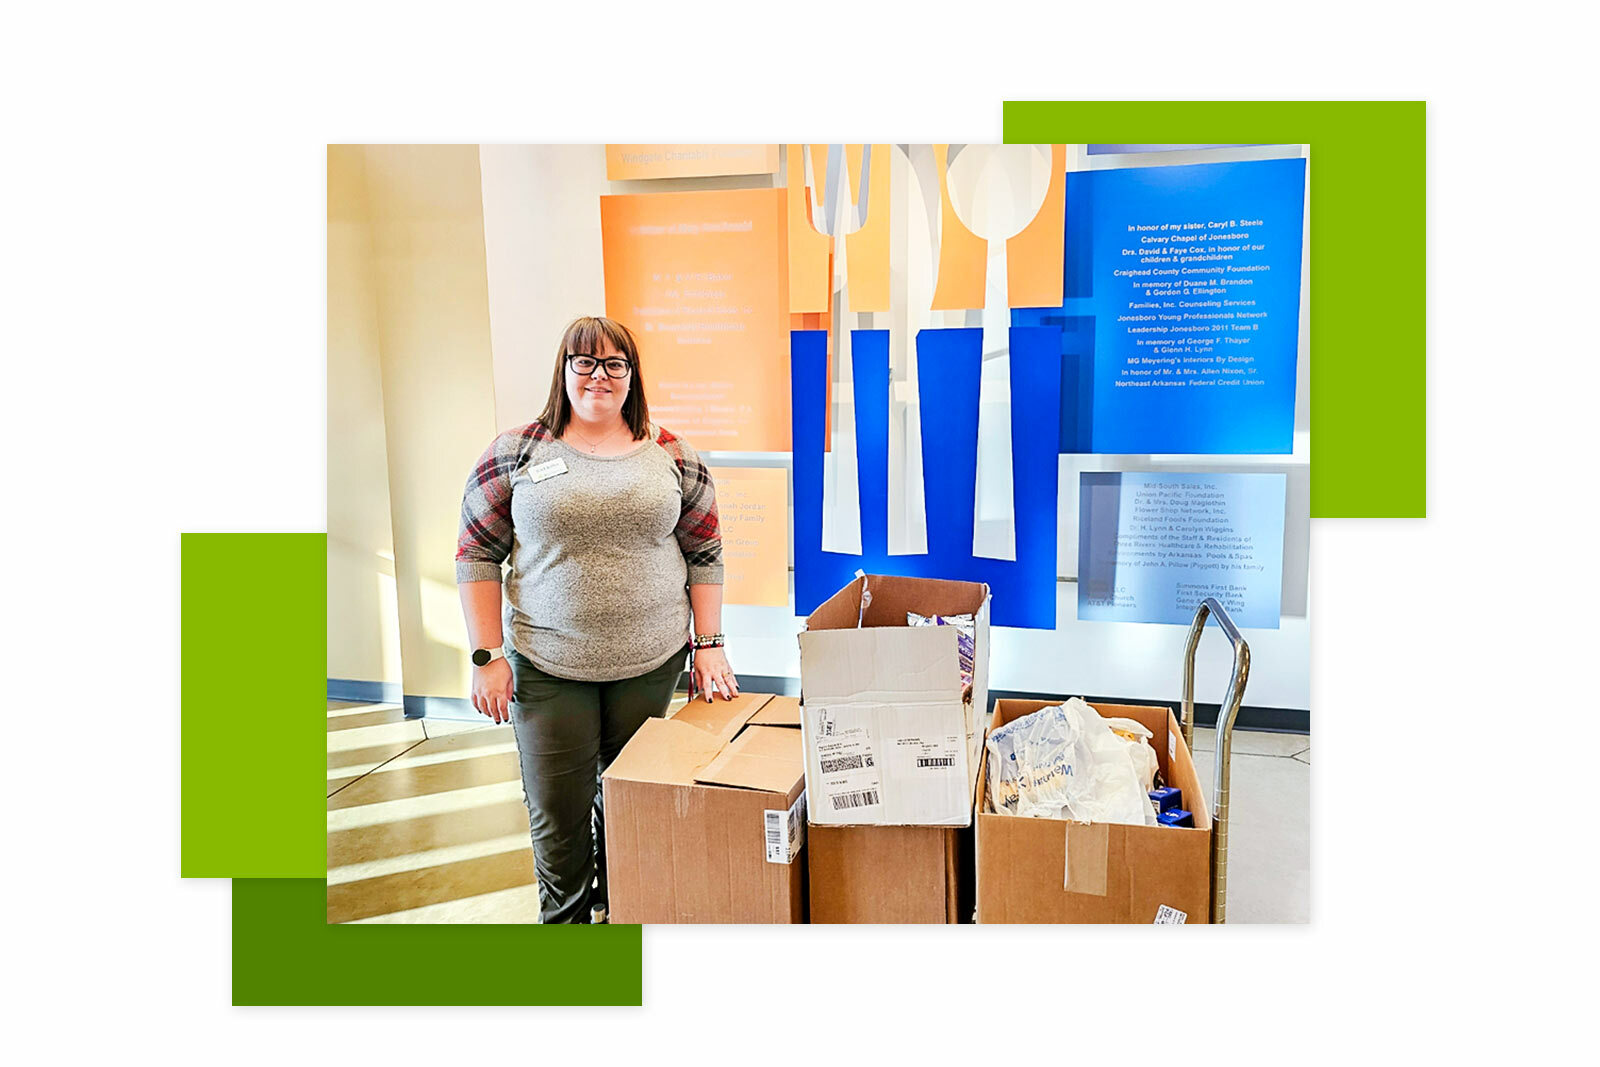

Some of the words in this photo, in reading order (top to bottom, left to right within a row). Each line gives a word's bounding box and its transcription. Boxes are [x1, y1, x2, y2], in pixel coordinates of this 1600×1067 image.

[1184, 222, 1205, 231] sister,
[1208, 221, 1228, 230] Caryl
[1240, 219, 1263, 227] Steele
[1141, 235, 1169, 245] Calvary
[1171, 234, 1197, 244] Chapel
[1209, 232, 1249, 240] Jonesboro
[1139, 247, 1160, 255] David
[1169, 246, 1187, 255] Faye
[1189, 246, 1205, 255] Cox,
[1217, 244, 1240, 252] honor
[1180, 254, 1233, 264] grandchildren
[1114, 268, 1151, 278] Craighead
[1153, 268, 1179, 277] County
[1181, 266, 1224, 276] Community
[1227, 265, 1270, 273] Foundation
[1183, 279, 1207, 287] Duane
[1153, 288, 1181, 296] Gordon
[1193, 287, 1226, 296] Ellington
[1129, 301, 1161, 310] Families,
[1179, 300, 1221, 309] Counseling
[1224, 299, 1255, 307] Services
[1159, 313, 1181, 322] Young
[1183, 312, 1234, 320] Professionals
[1128, 325, 1168, 335] Leadership
[1187, 338, 1213, 346] George
[1225, 337, 1250, 346] Thayer
[1195, 346, 1213, 354] Lynn
[1142, 357, 1180, 366] Meyering's
[1216, 356, 1225, 365] By
[1228, 356, 1254, 364] Design
[1222, 368, 1245, 376] Nixon,
